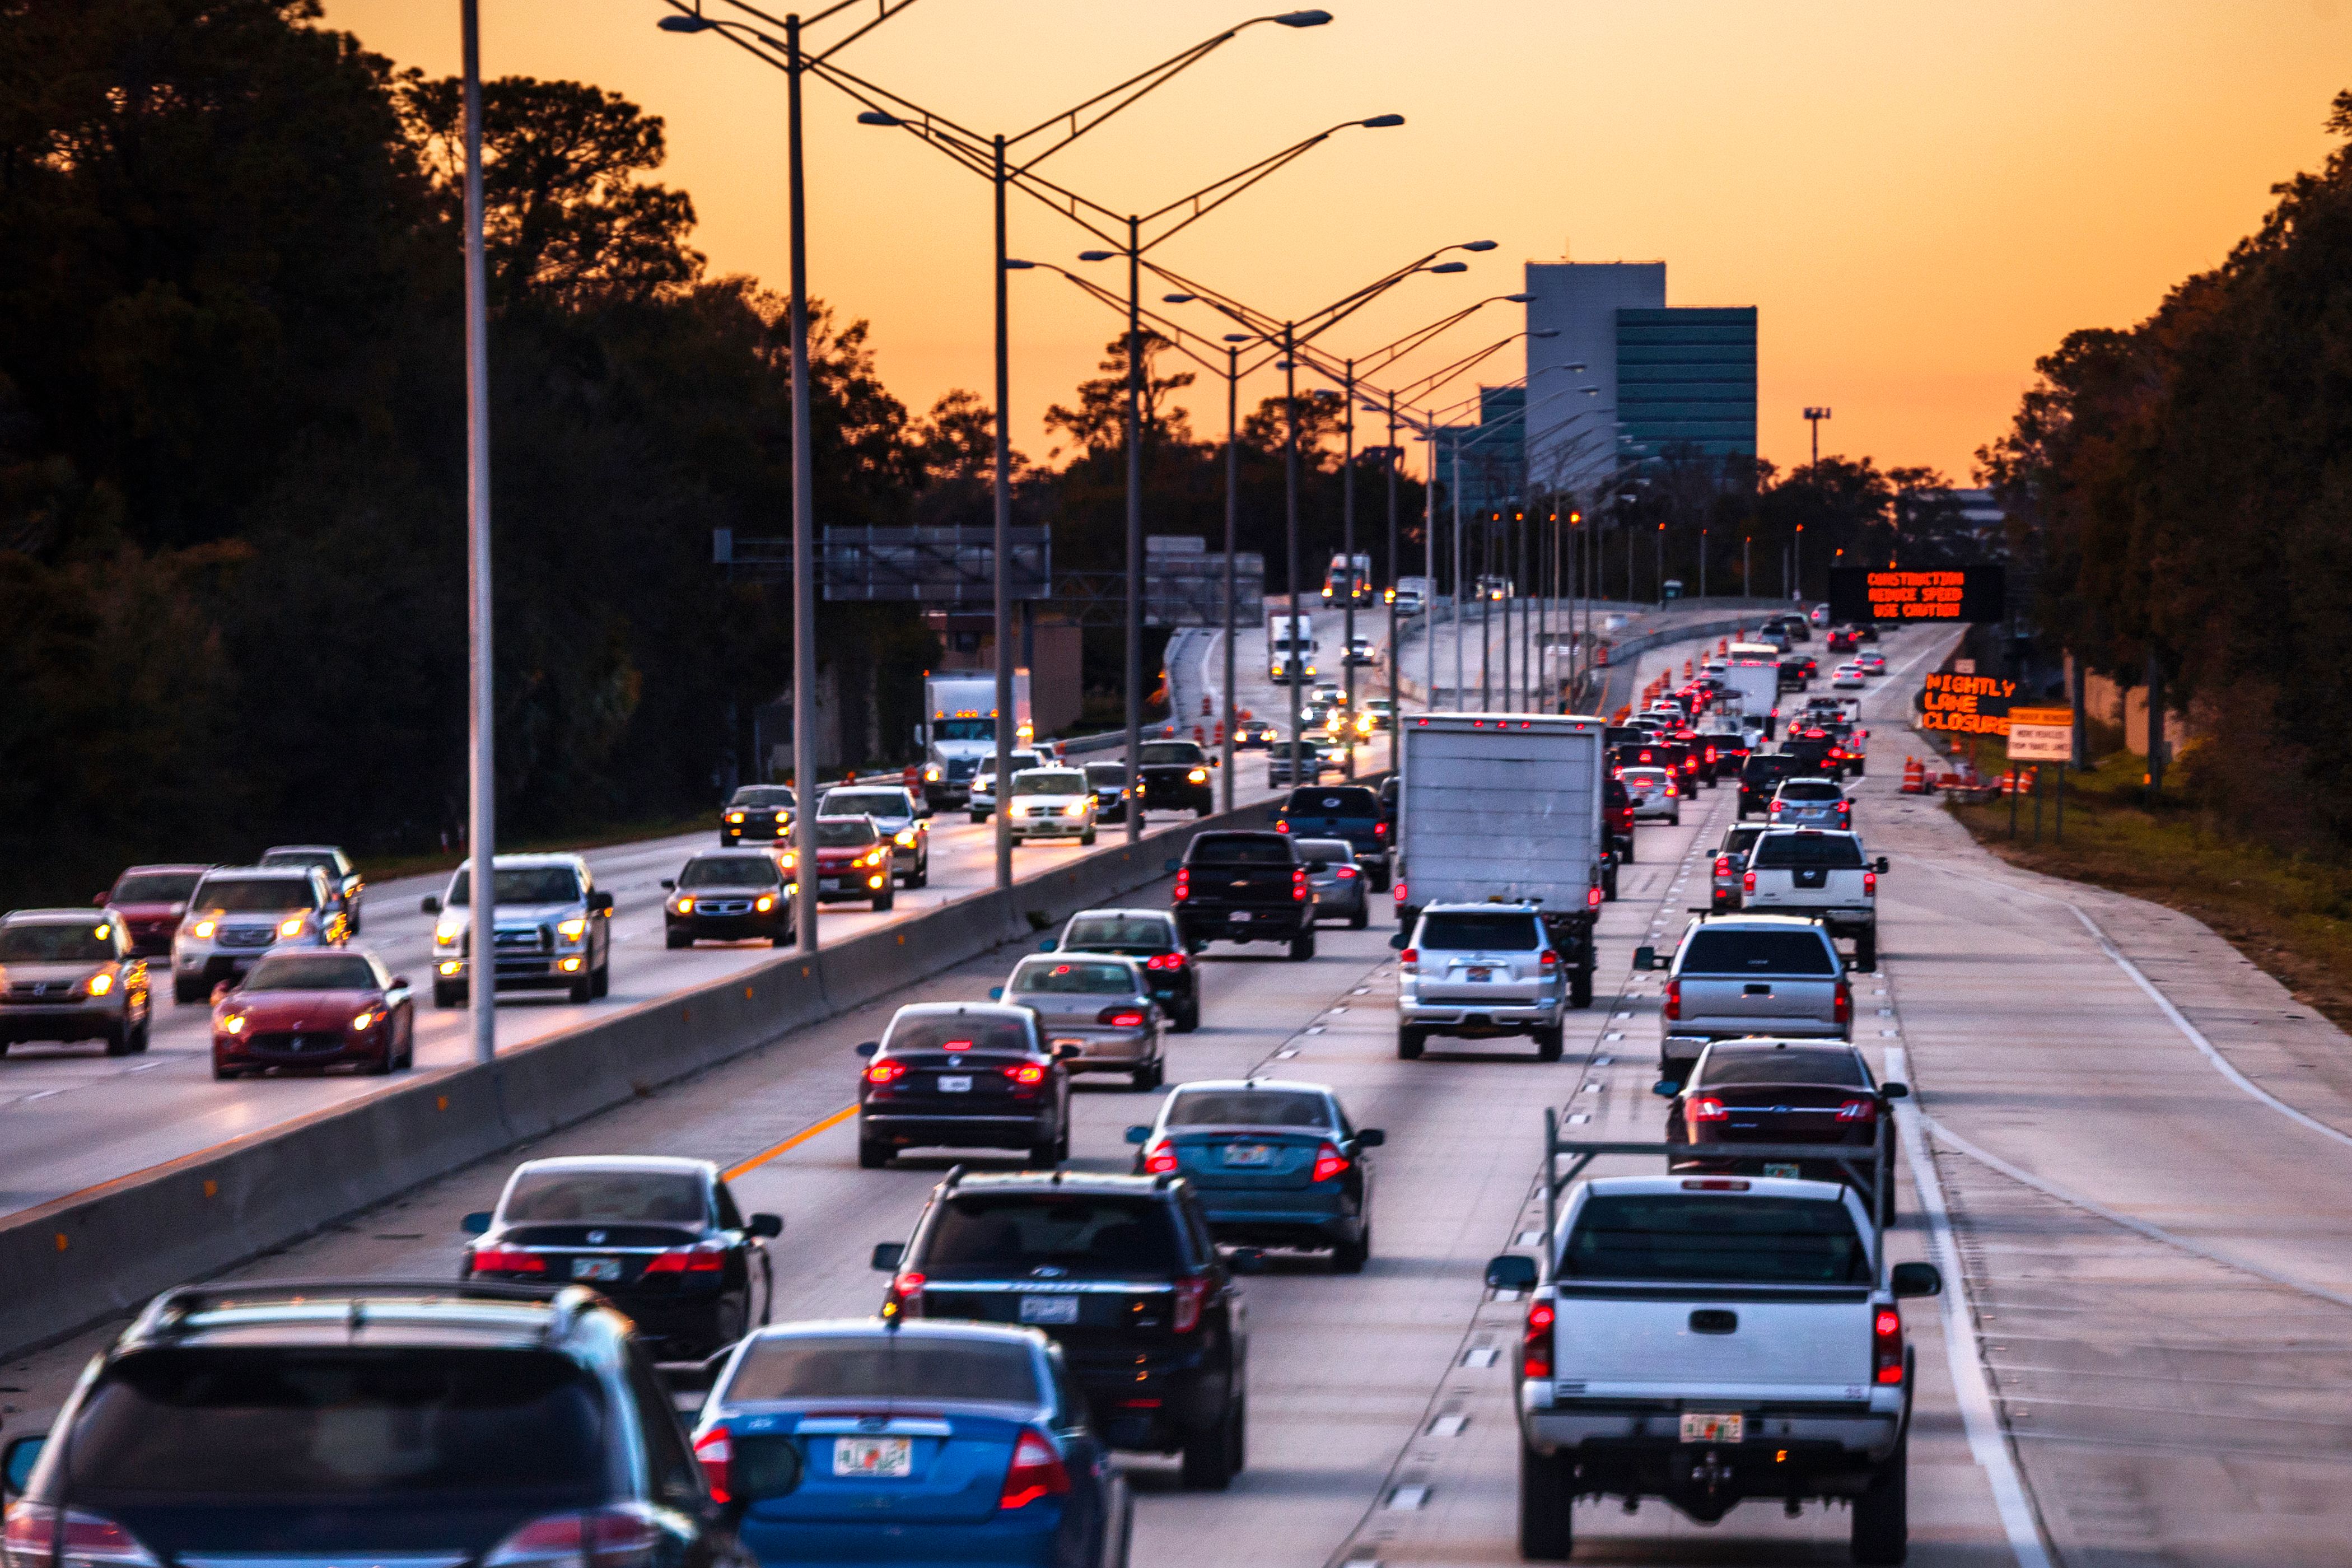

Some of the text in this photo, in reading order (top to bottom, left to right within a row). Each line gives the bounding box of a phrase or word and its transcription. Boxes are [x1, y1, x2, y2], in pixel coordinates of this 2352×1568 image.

[1868, 572, 1964, 586] CONSTRUCTION
[1868, 587, 1963, 602] REDUCE SPEED
[1873, 603, 1960, 617] USE CAUTION
[1926, 673, 2016, 698] NIGHTLY
[1924, 692, 1978, 713] LANE
